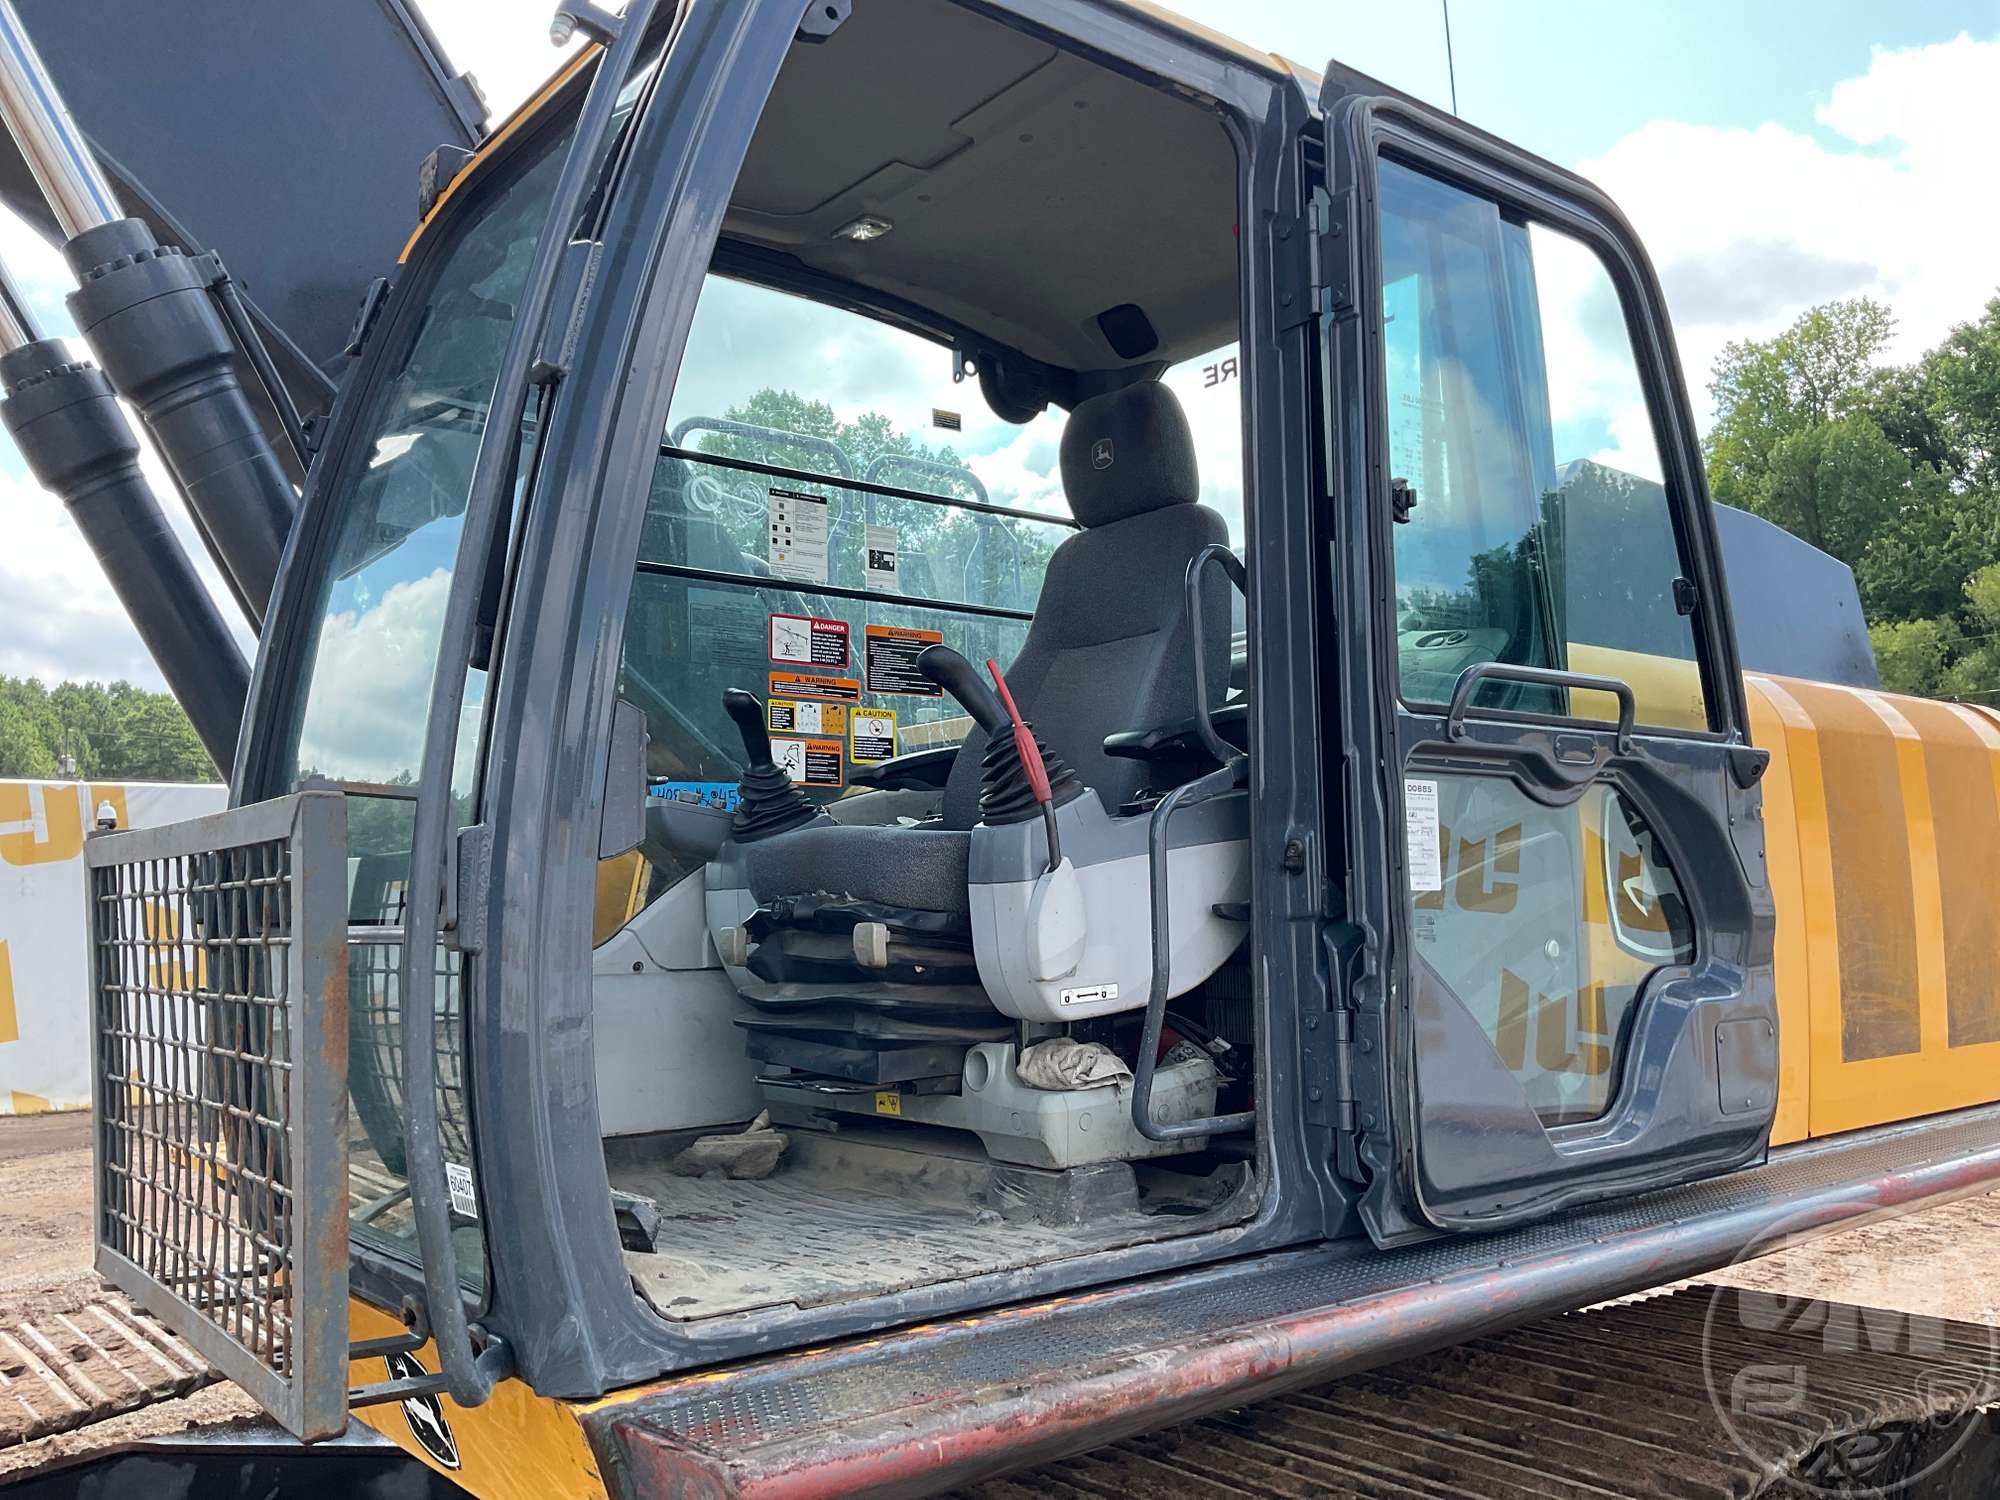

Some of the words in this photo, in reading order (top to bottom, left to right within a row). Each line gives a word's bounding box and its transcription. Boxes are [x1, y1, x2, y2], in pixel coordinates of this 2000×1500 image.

[820, 623, 845, 631] DANGER
[893, 630, 922, 638] WARNING
[805, 676, 836, 685] WARNING
[863, 710, 892, 718] CAUTION
[812, 744, 840, 752] WARNING
